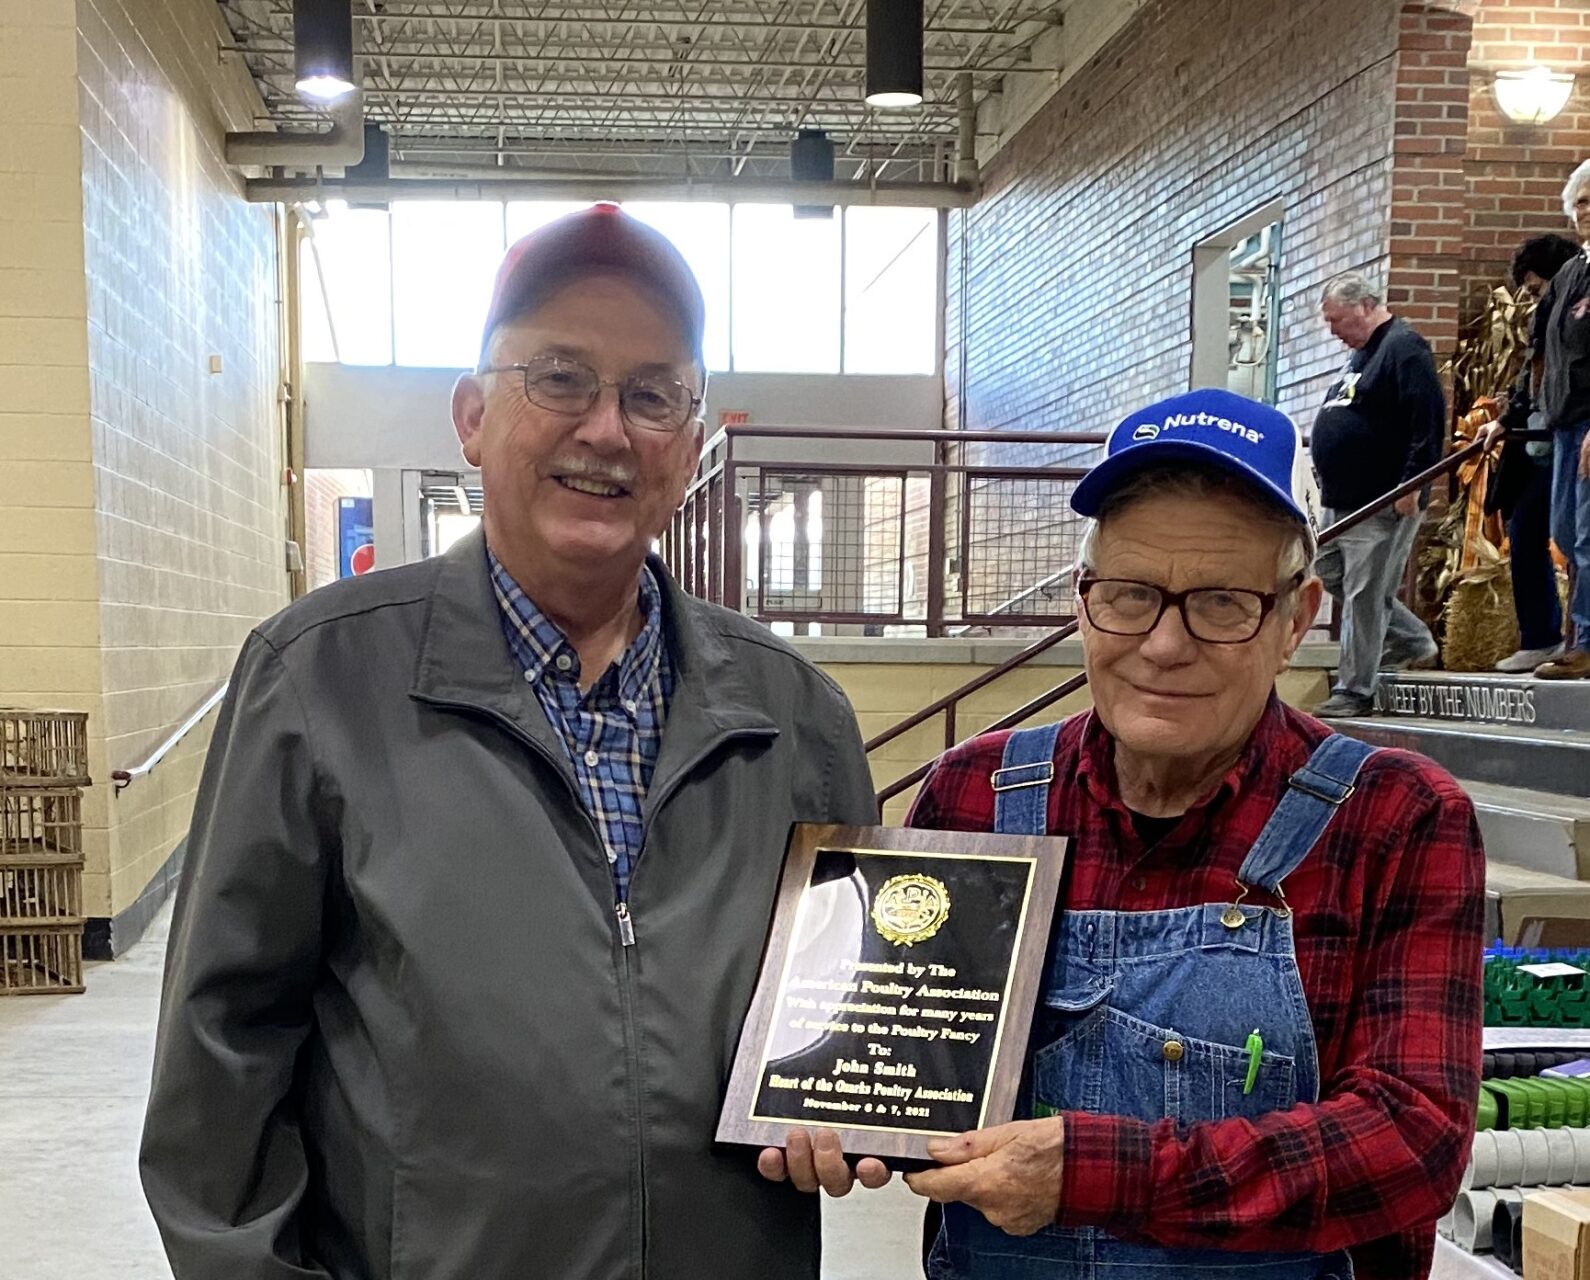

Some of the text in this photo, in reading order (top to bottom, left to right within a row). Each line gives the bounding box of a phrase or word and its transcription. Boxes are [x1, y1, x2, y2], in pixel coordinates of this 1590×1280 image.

[1162, 411, 1260, 444] Nutrena
[1387, 684, 1416, 714] BEEF
[1419, 685, 1434, 715] BY
[1436, 685, 1464, 716] THE
[1465, 686, 1536, 723] NUMBERS
[907, 962, 926, 979] by
[928, 963, 957, 977] The
[861, 980, 914, 999] Poultry
[915, 984, 1000, 1002] Association
[786, 996, 994, 1023] With appreciation for many years
[788, 1017, 806, 1029] of
[851, 1023, 866, 1033] to
[867, 1022, 889, 1035] the
[891, 1024, 939, 1041] Poultry
[940, 1027, 980, 1044] Fancy
[867, 1043, 892, 1056] To:
[832, 1058, 917, 1077] John Smith
[768, 1074, 799, 1089] Heart
[800, 1077, 815, 1090] of
[815, 1078, 833, 1092] the
[873, 1082, 913, 1102] Poultry
[914, 1086, 974, 1103] Association
[803, 1097, 861, 1111] November
[890, 1104, 901, 1117] 7,
[904, 1106, 930, 1118] 2021
